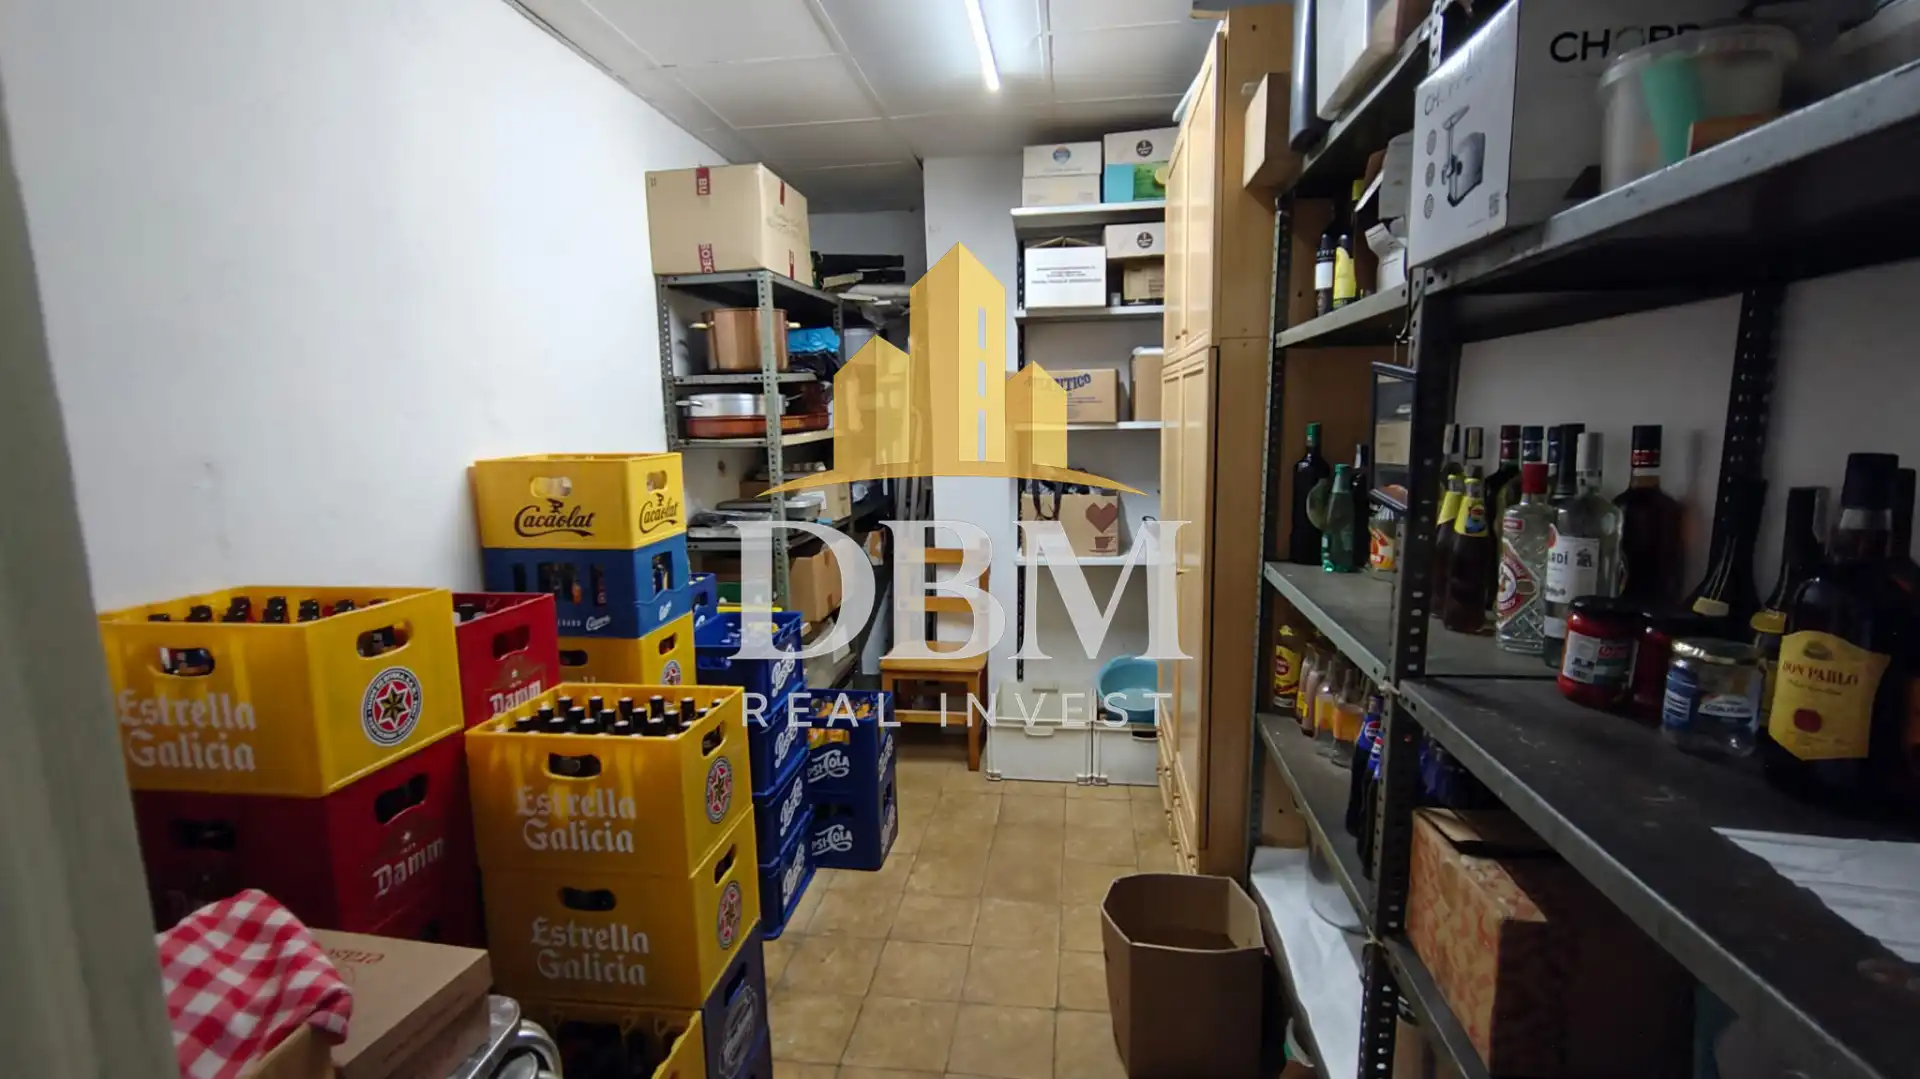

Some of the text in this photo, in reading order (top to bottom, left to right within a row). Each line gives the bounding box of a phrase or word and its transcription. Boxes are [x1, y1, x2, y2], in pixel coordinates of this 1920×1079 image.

[1550, 23, 1701, 63] CHOP
[514, 505, 596, 538] Cacaolat
[639, 497, 679, 534] Cacaolat
[118, 689, 257, 732] Estrella
[489, 680, 541, 718] Damm
[129, 728, 257, 772] Galicia
[516, 786, 637, 819] Estrella
[524, 818, 635, 853] Galicia
[372, 837, 445, 899] Damm
[531, 916, 650, 954] Estrella
[537, 948, 647, 986] Galicia
